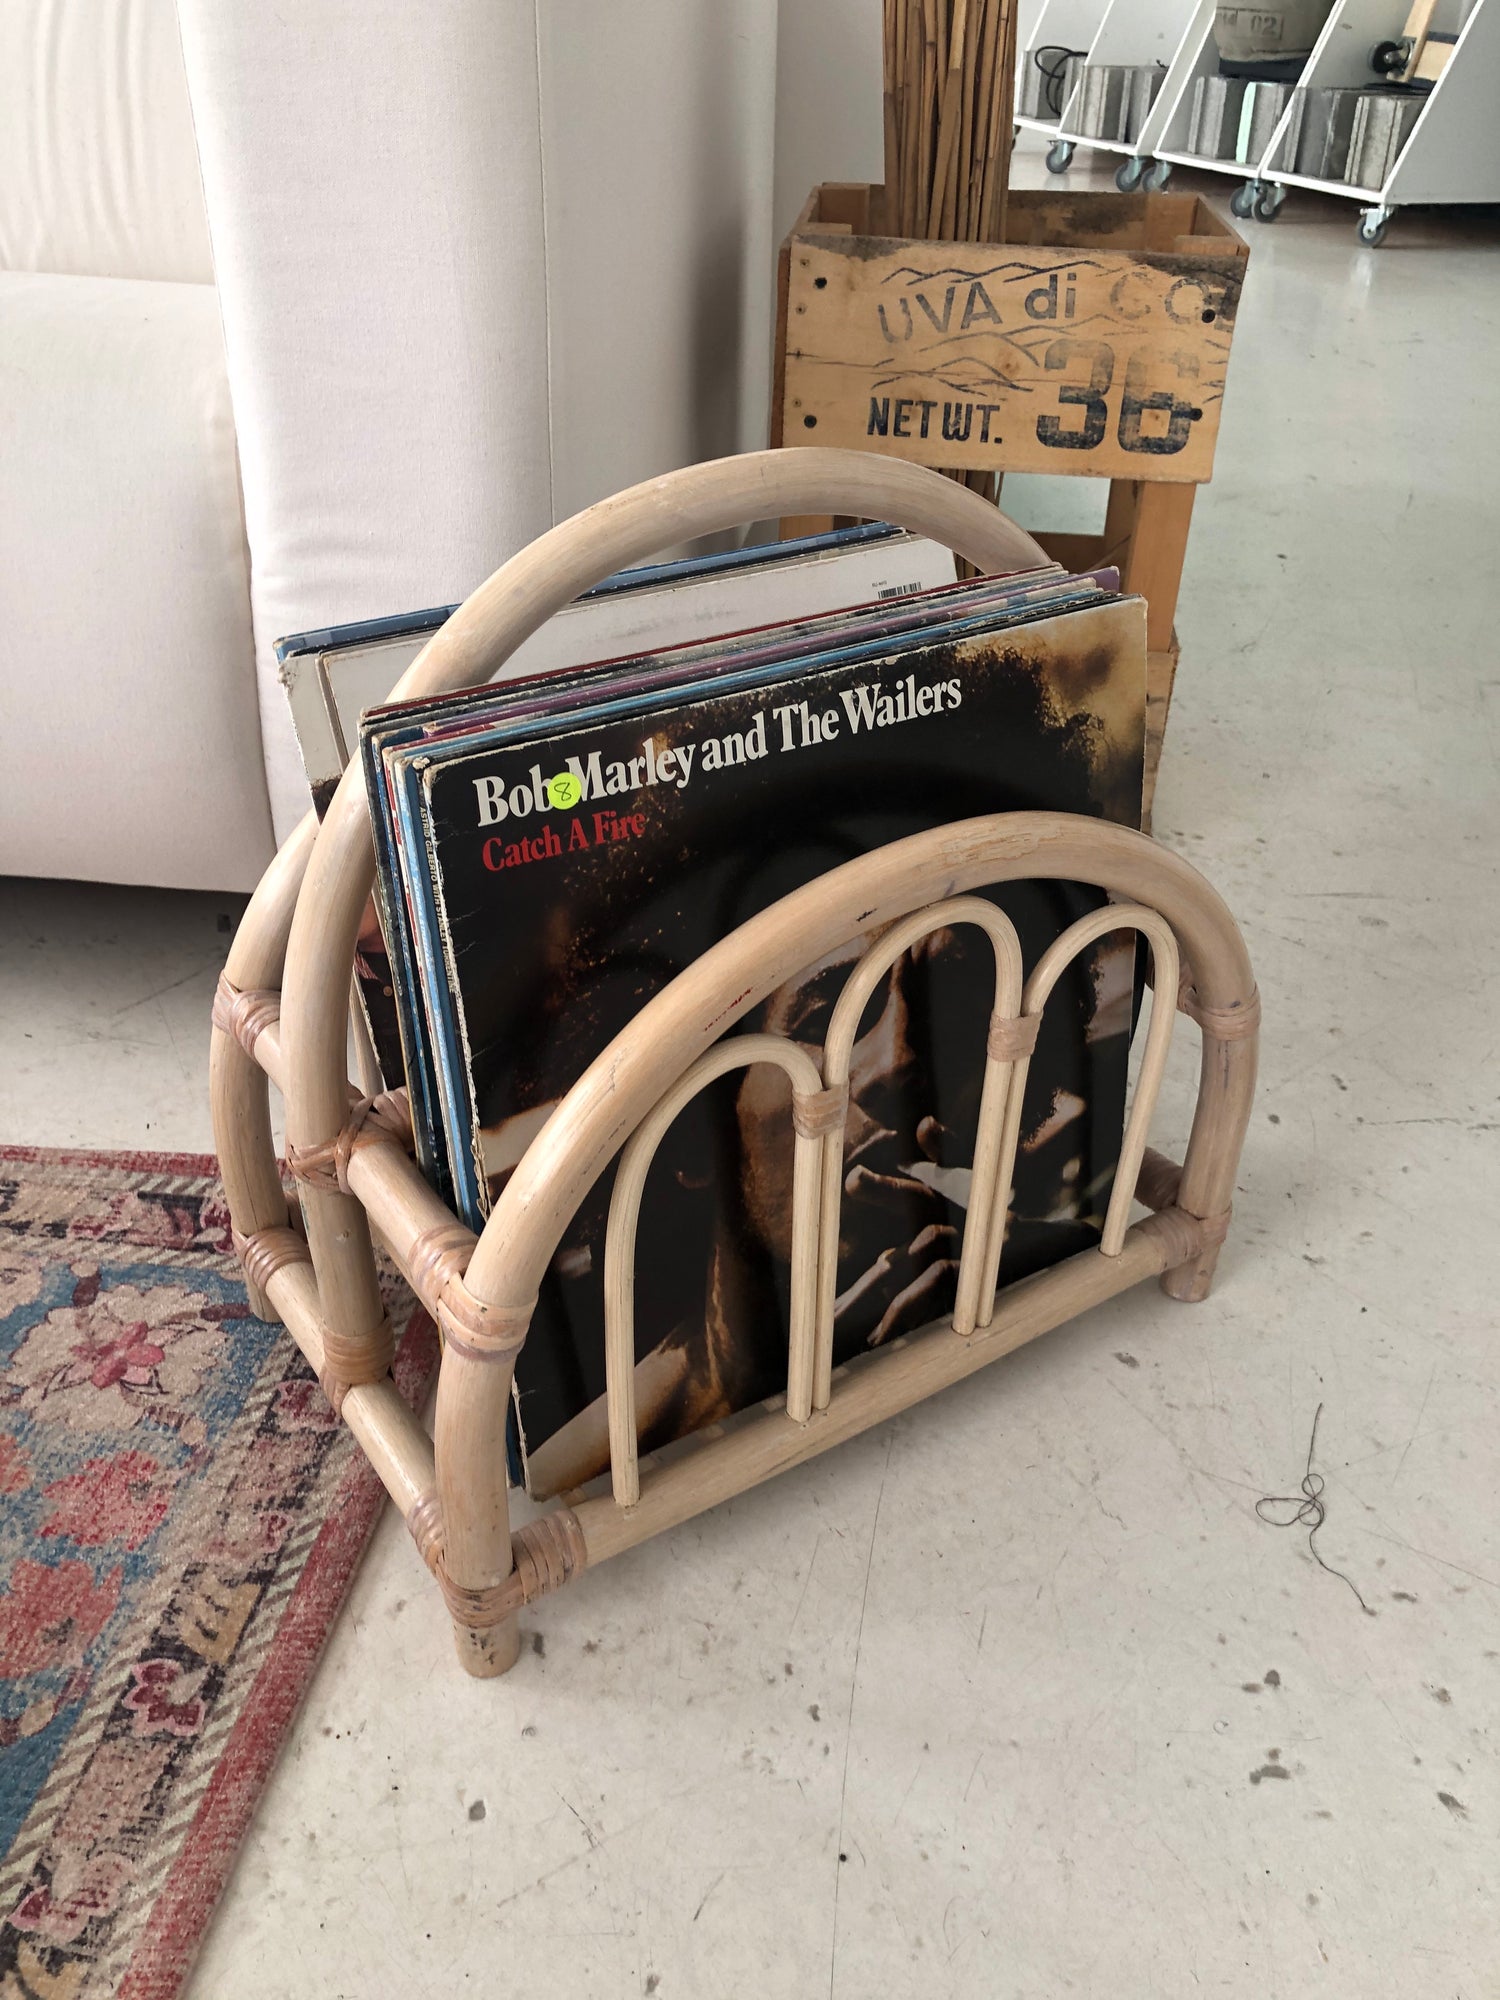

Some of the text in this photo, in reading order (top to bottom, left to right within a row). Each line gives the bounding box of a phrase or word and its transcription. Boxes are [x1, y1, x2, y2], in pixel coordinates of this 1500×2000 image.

[877, 281, 1003, 344] UVA
[1024, 271, 1077, 320] di
[1036, 338, 1199, 455] 36
[473, 764, 553, 828] Bob
[565, 742, 697, 803] Marley
[701, 713, 768, 773] and
[773, 699, 839, 754] The
[838, 673, 963, 735] Wailers
[553, 781, 573, 803] 8
[482, 808, 647, 872] Catch A Fire
